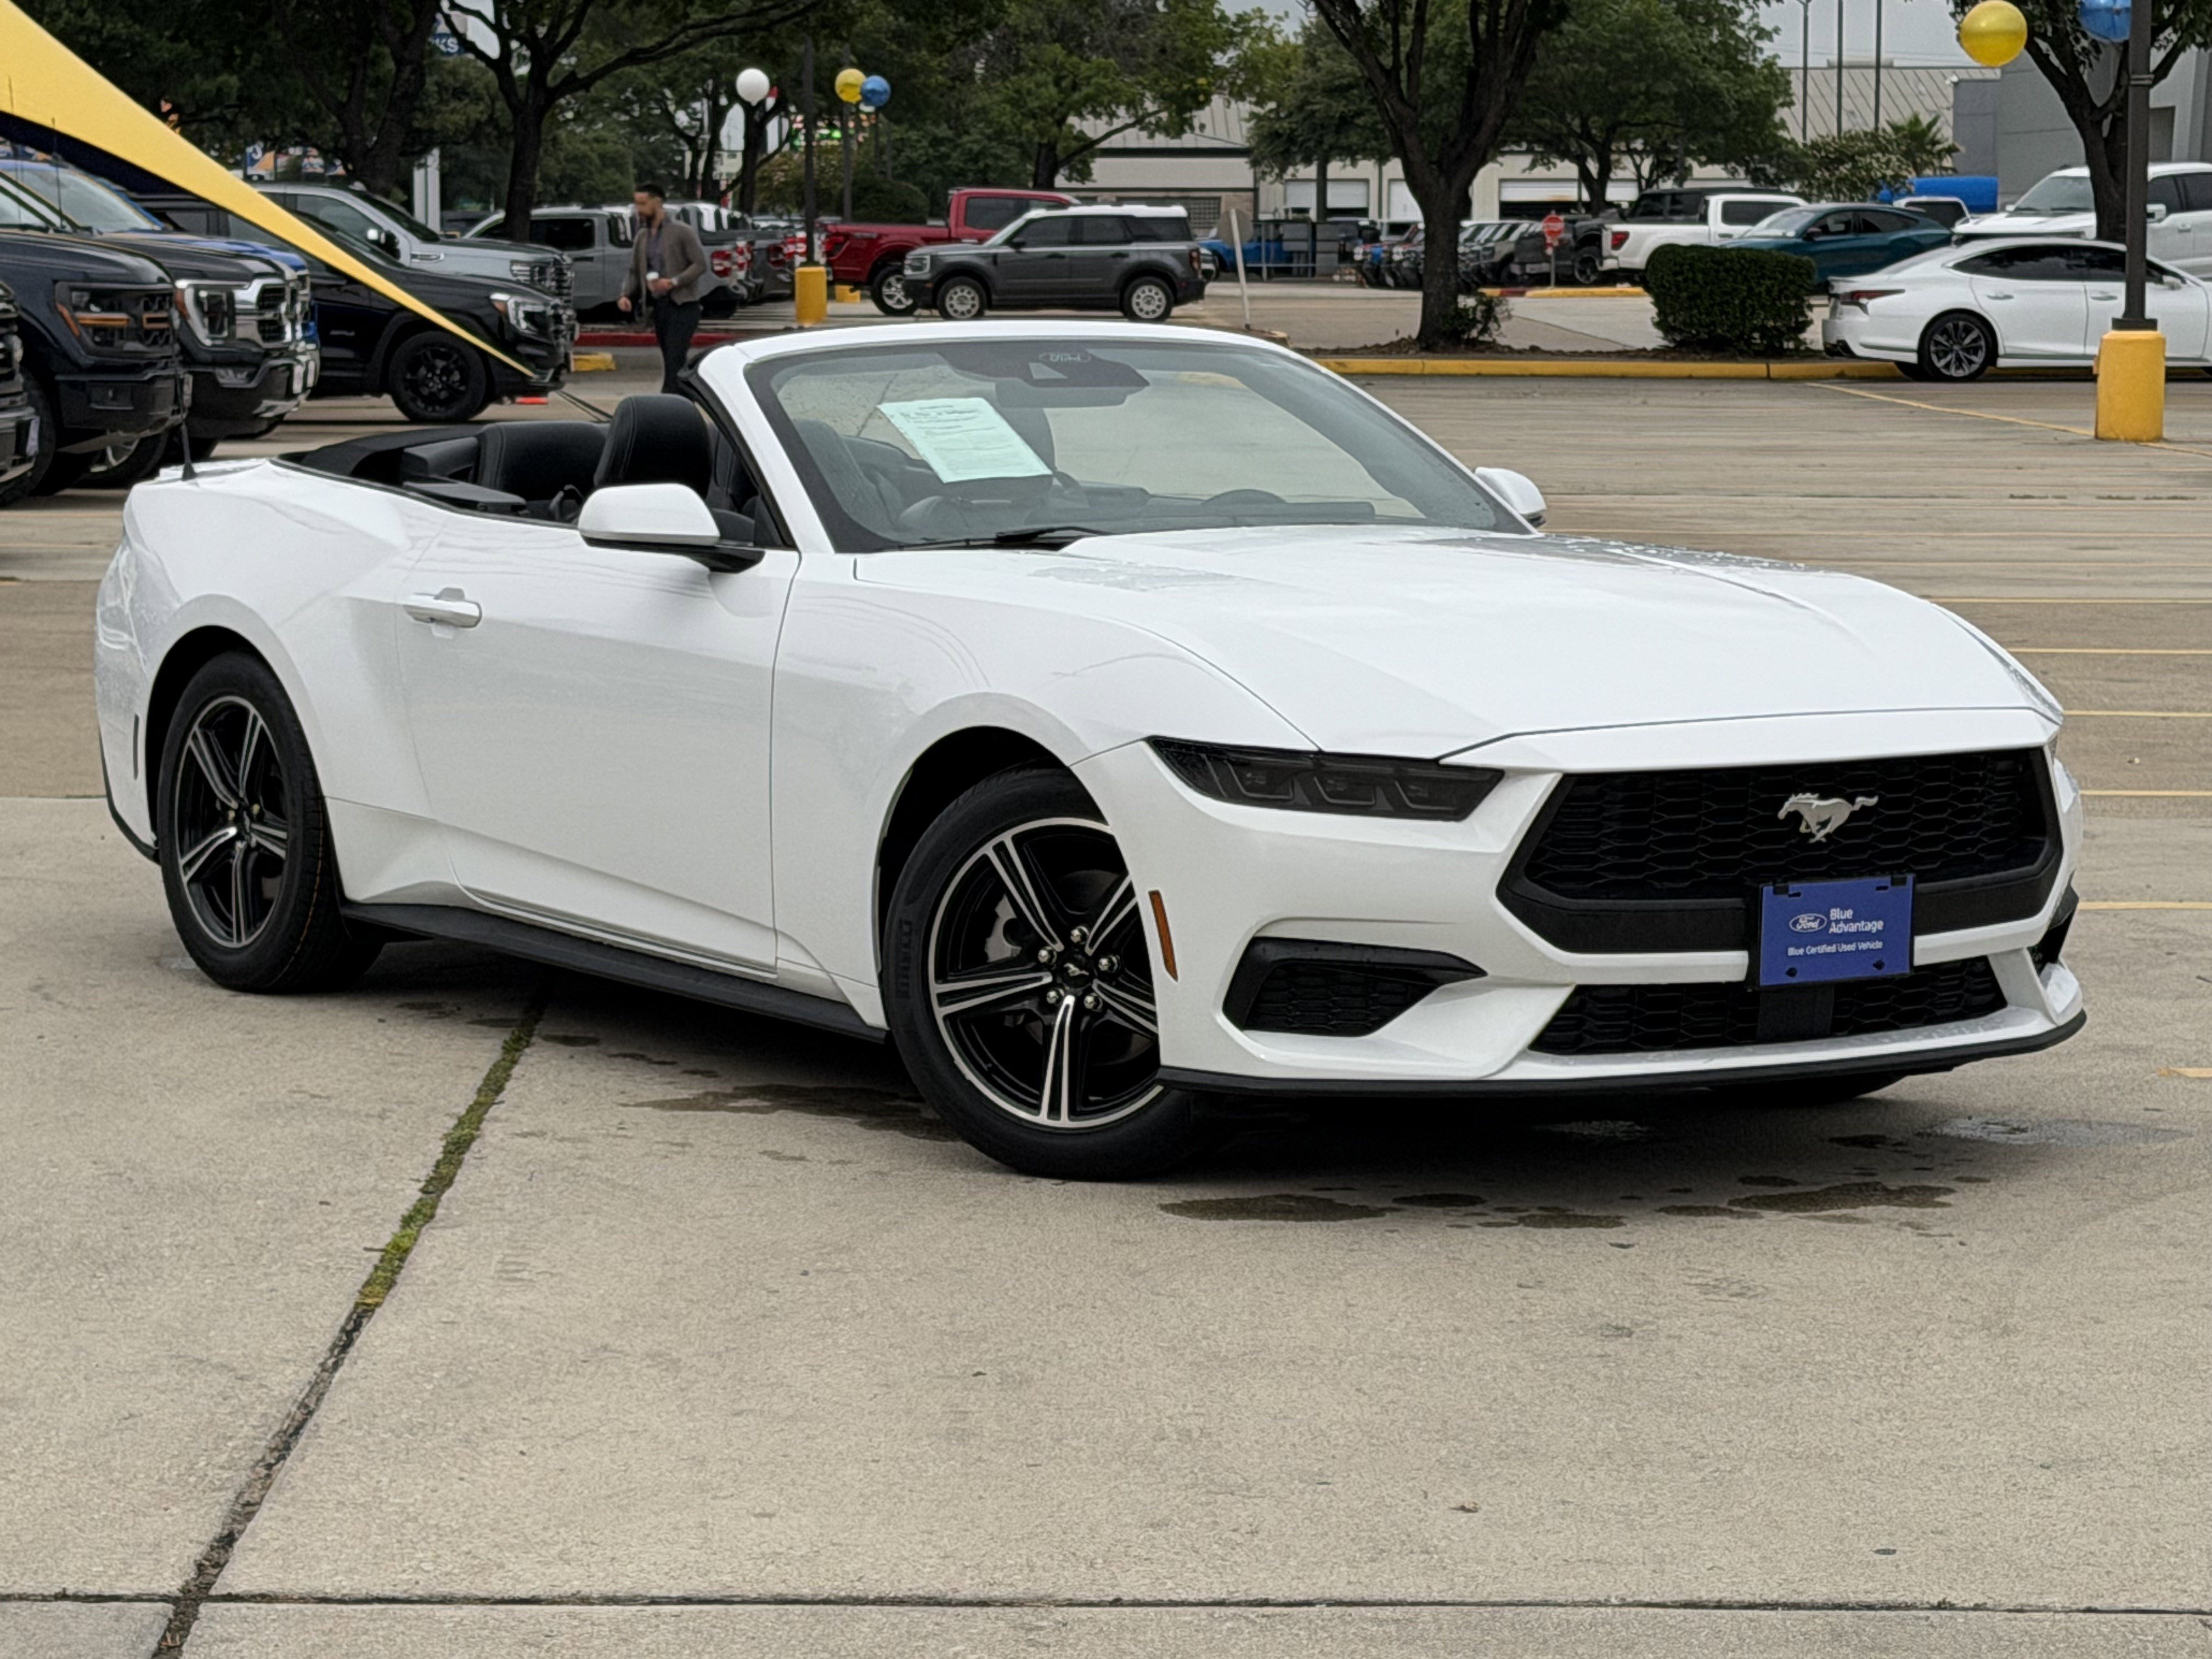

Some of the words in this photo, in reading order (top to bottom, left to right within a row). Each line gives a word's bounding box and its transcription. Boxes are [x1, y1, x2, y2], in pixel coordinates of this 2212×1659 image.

[430, 38, 459, 53] KS
[1830, 907, 1854, 921] Blue
[1796, 916, 1821, 930] Ford
[1828, 920, 1884, 934] Advantage
[1787, 946, 1805, 956] Blue
[1805, 944, 1837, 955] Certified
[1837, 941, 1857, 952] Used
[1857, 940, 1883, 951] Vehicle
